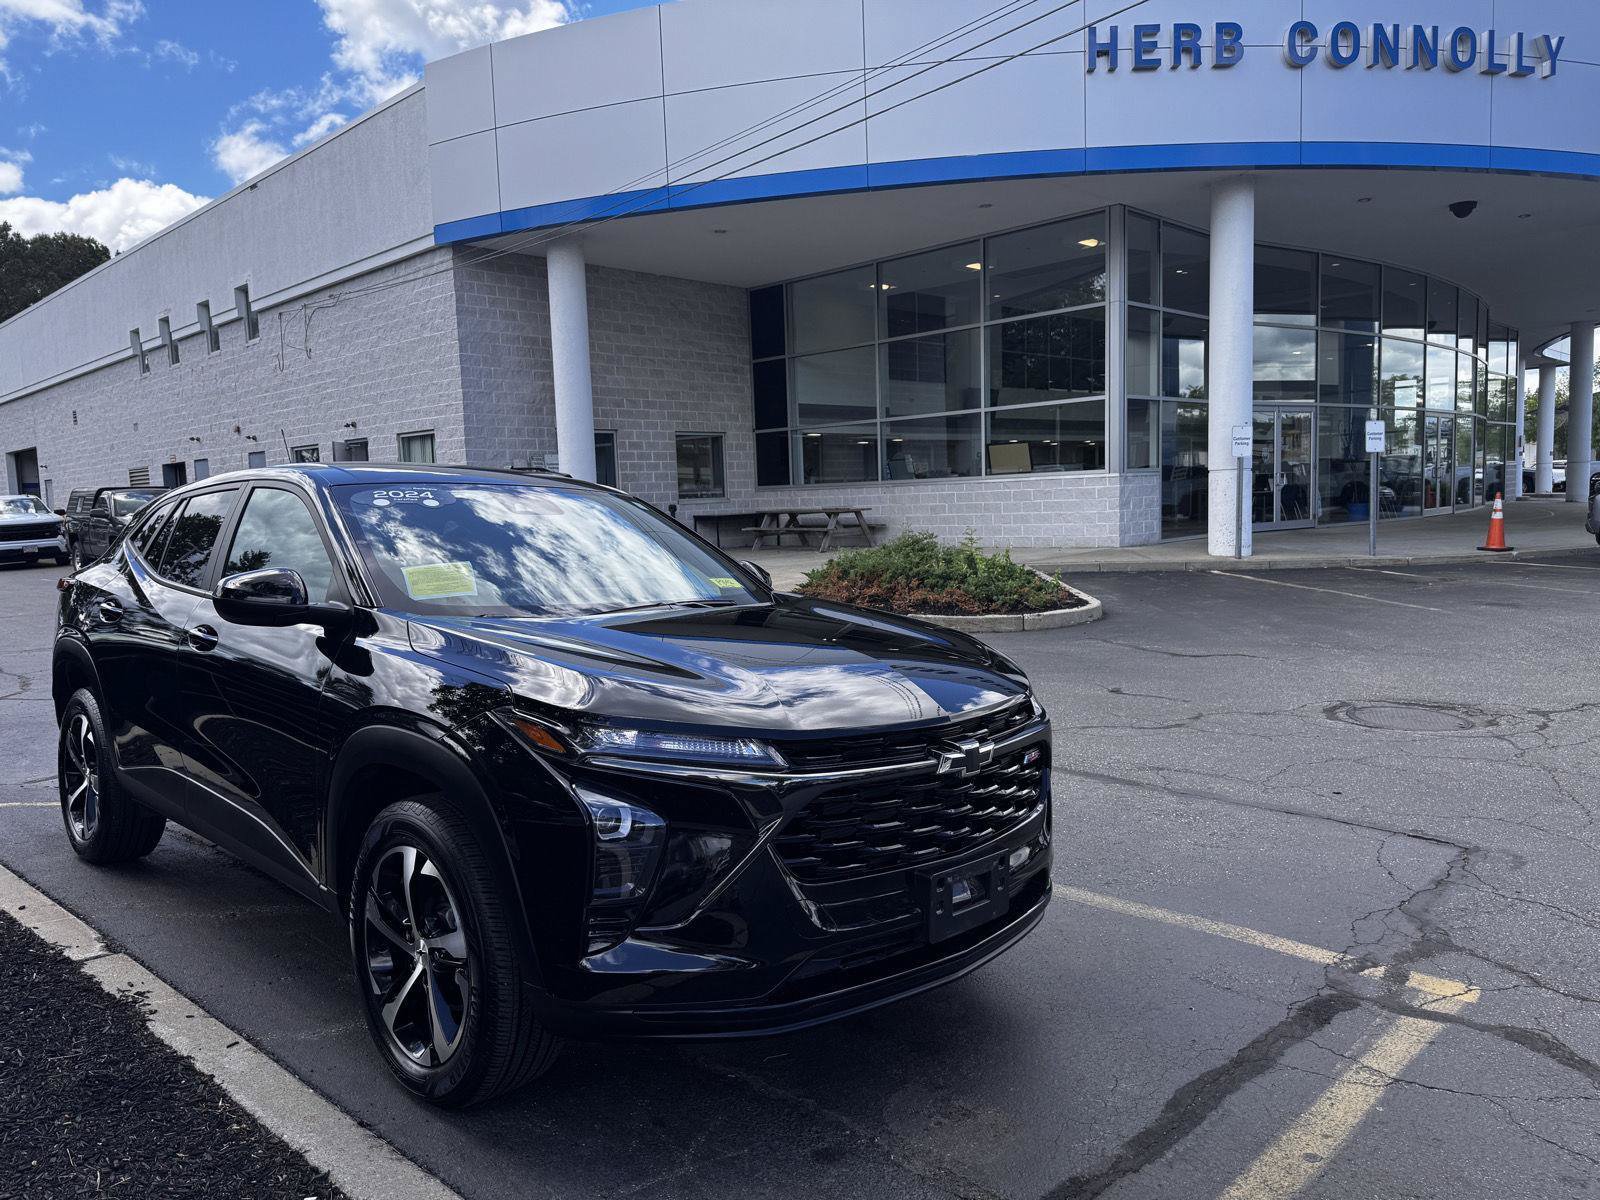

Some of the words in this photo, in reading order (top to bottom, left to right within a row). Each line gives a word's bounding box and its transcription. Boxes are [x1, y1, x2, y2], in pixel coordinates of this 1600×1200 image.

[1086, 22, 1244, 72] HERB
[1283, 20, 1565, 79] CONNOLLY
[372, 490, 435, 498] 2024
